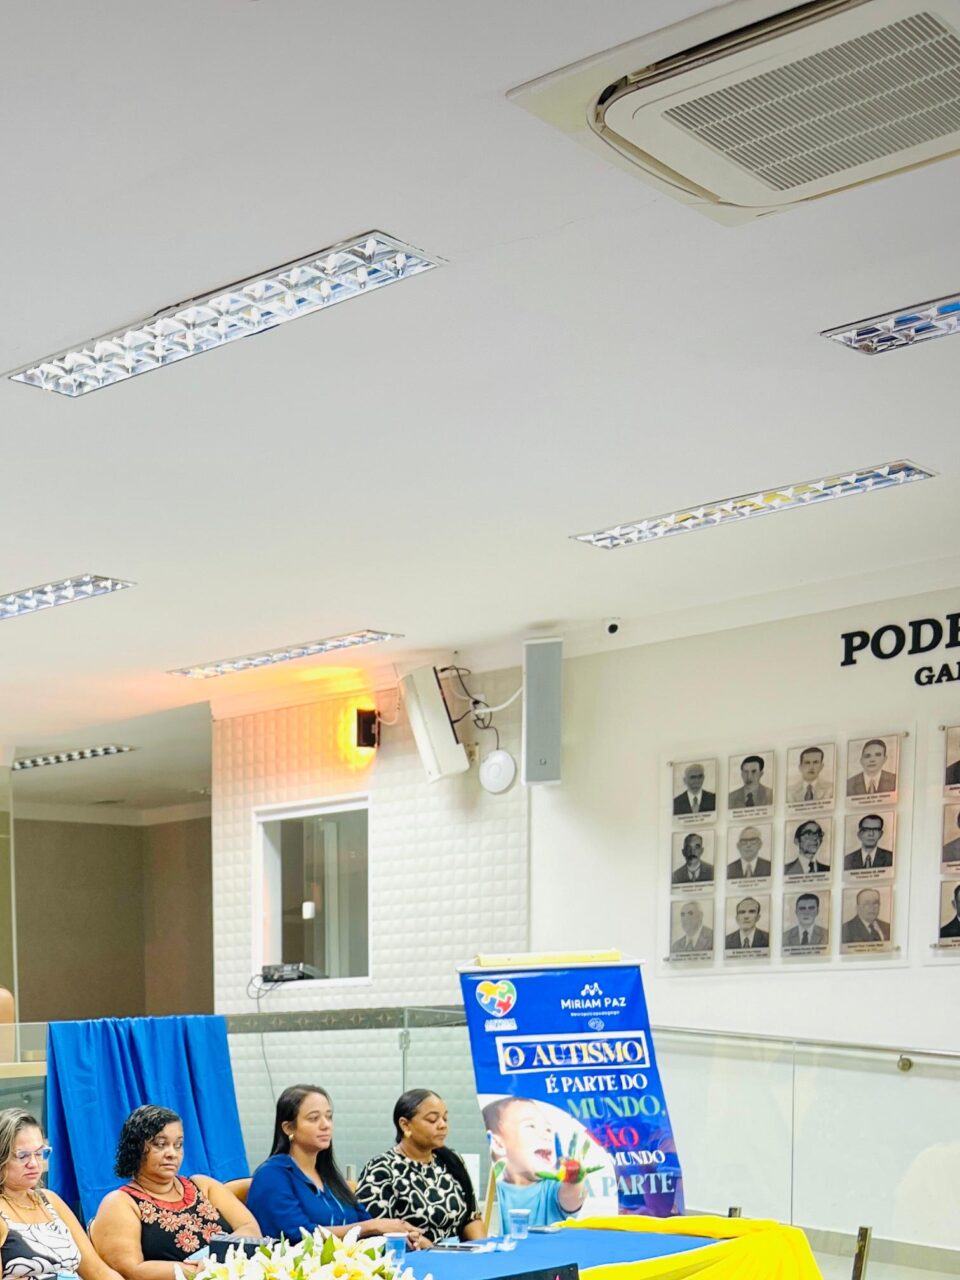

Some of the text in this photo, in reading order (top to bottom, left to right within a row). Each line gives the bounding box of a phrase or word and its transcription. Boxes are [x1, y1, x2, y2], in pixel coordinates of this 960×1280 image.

[914, 661, 960, 686] GA
[560, 997, 627, 1010] MIRIAM PAZ
[504, 1040, 644, 1067] O AUTISMO
[545, 1073, 648, 1094] É PARTE DO
[601, 1171, 675, 1198] PARTE
